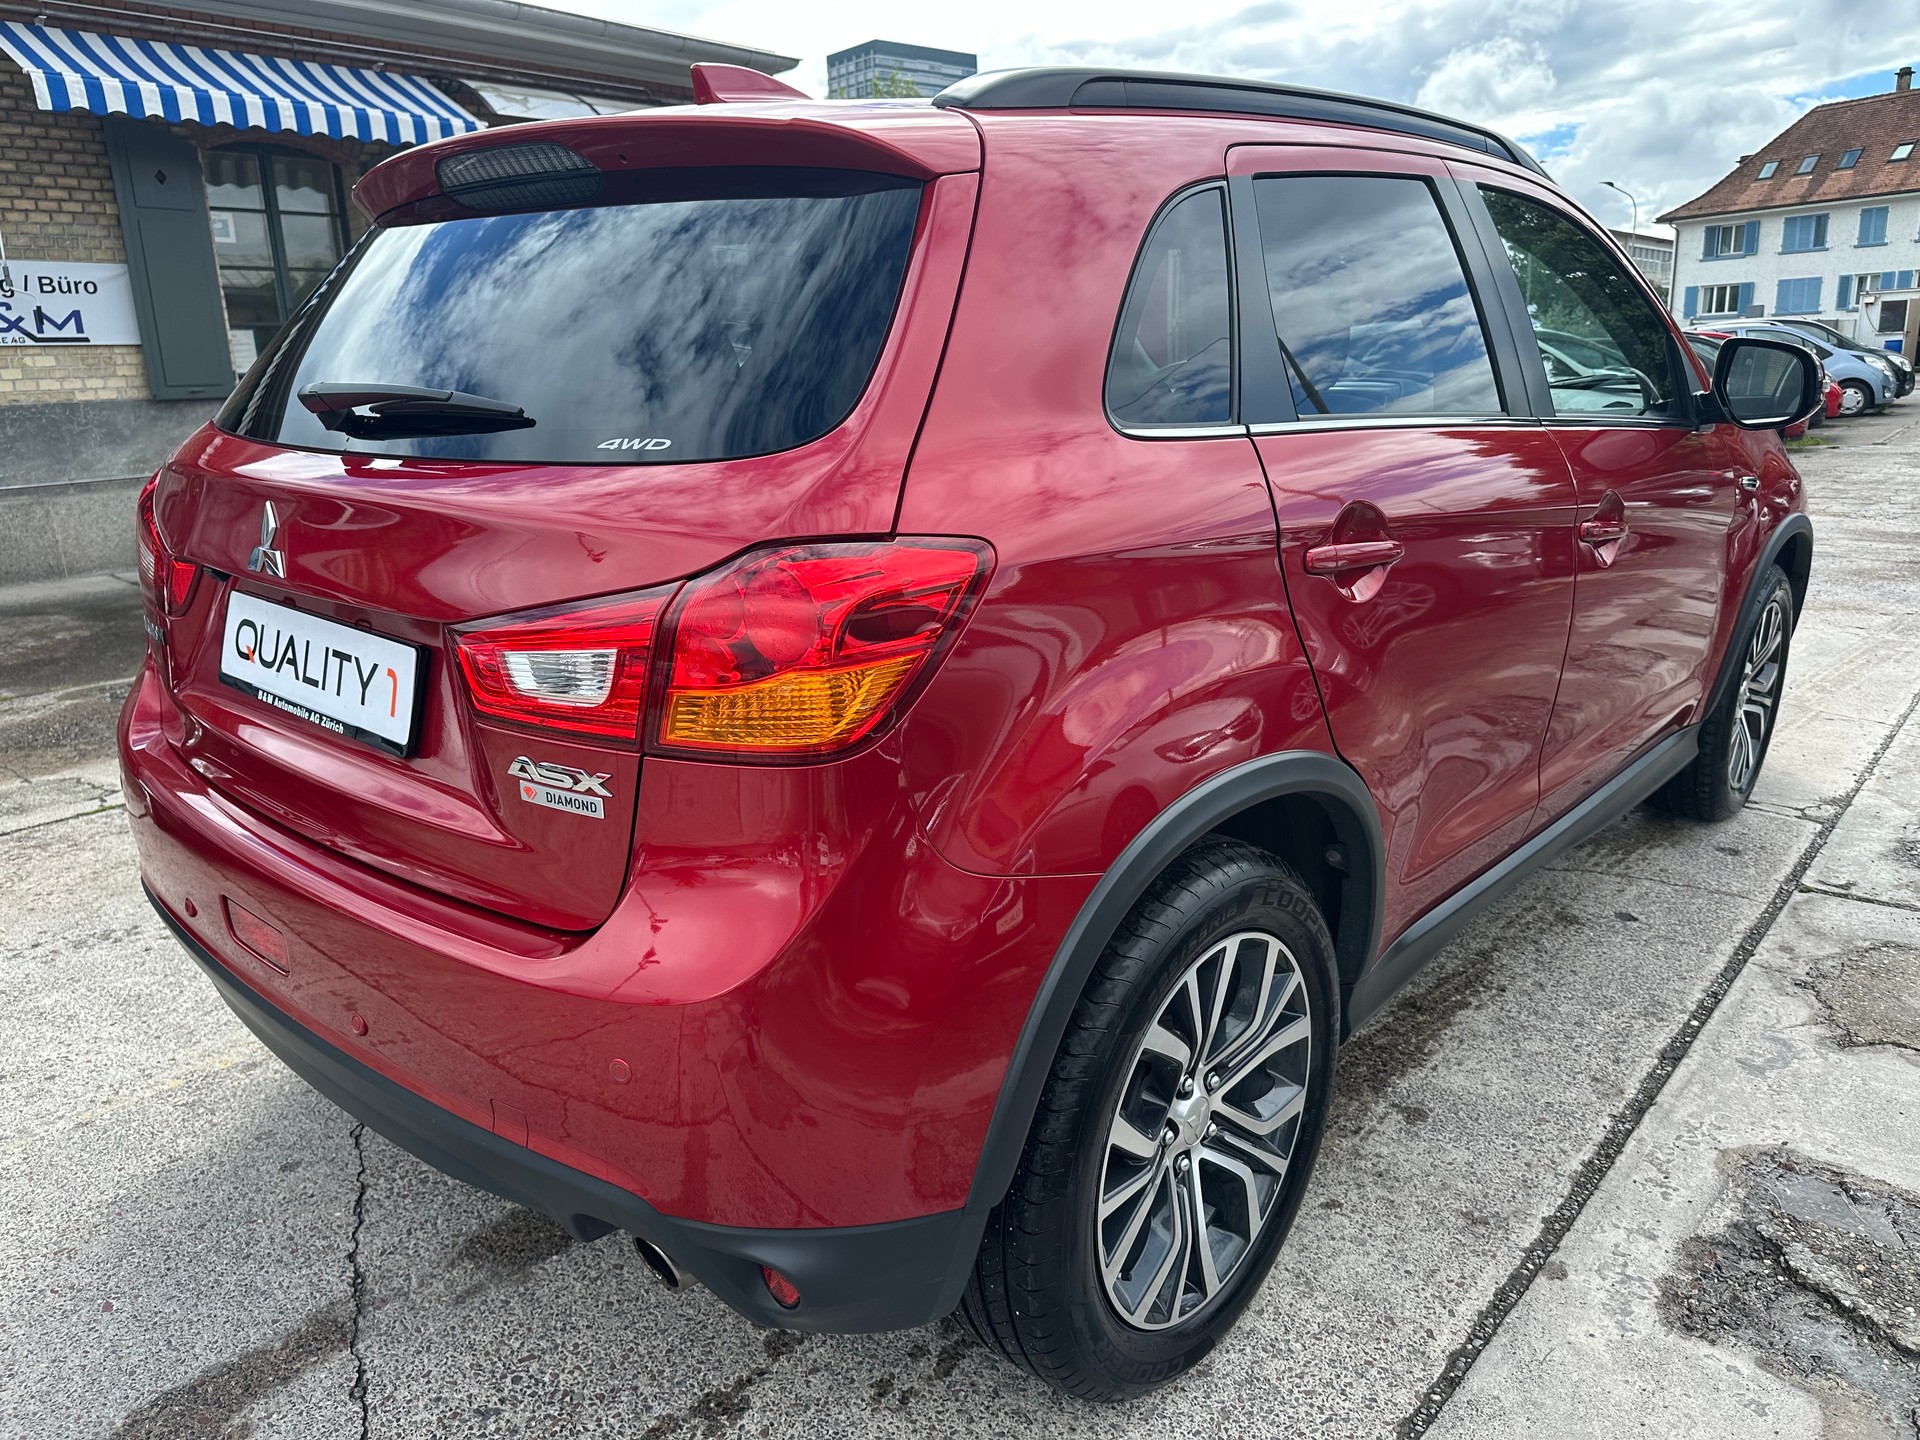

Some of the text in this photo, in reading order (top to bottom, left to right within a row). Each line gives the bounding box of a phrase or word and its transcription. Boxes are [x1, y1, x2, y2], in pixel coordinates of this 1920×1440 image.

[37, 275, 98, 295] Büro
[596, 438, 672, 450] 4WD
[273, 697, 310, 720] Automobile
[309, 711, 321, 725] AG
[320, 716, 345, 735] Zürich
[507, 755, 614, 798] ASX
[545, 791, 598, 814] DIAMOND
[1262, 886, 1336, 961] COOPER
[1093, 1337, 1186, 1384] COOPER
